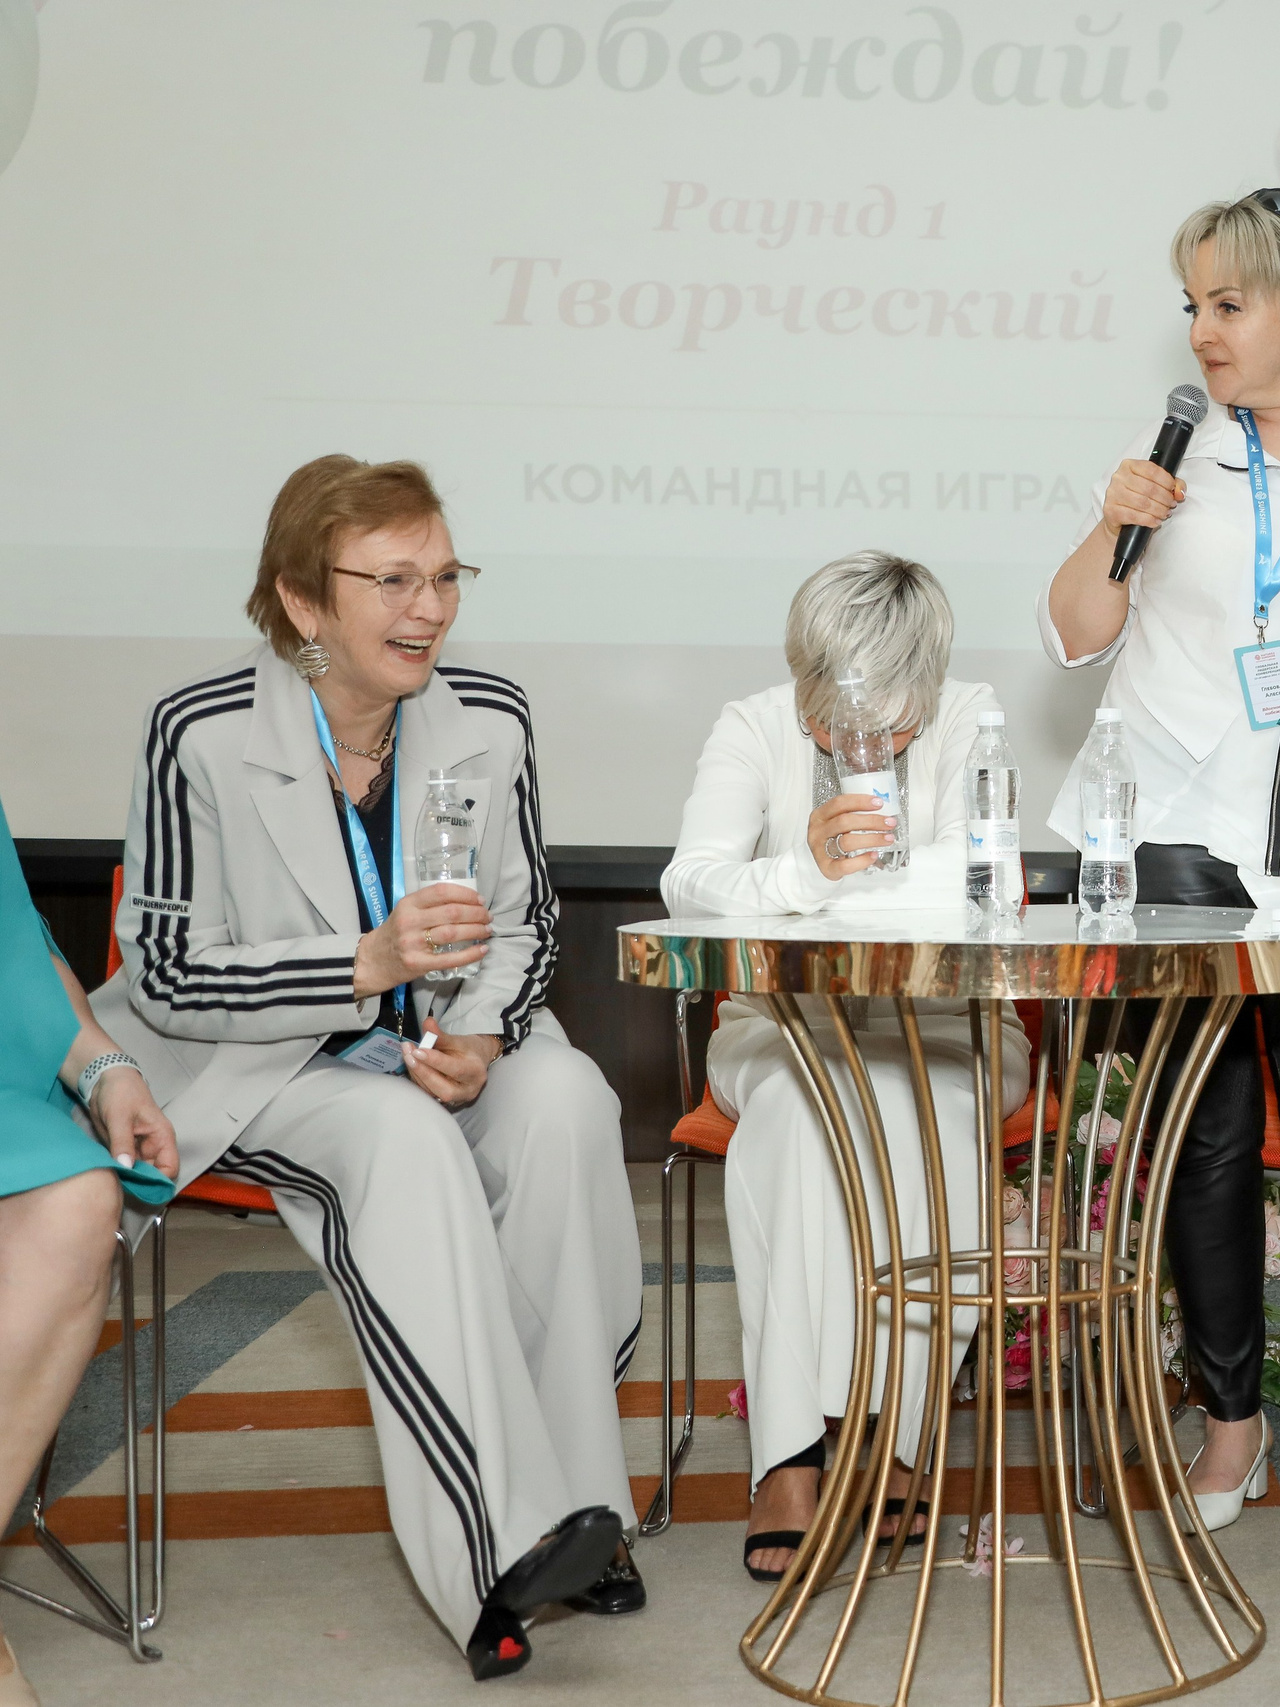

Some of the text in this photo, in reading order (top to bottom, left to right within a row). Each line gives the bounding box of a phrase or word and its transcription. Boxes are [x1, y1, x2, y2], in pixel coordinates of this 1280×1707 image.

[416, 0, 1185, 113] побеждай!
[652, 179, 949, 251] Раунд 1
[489, 255, 1118, 353] Творческий
[522, 461, 1082, 515] КОМАНДНАЯ ИГРА
[1257, 500, 1267, 535] SUNSHINE
[368, 885, 385, 927] SUNSHIN
